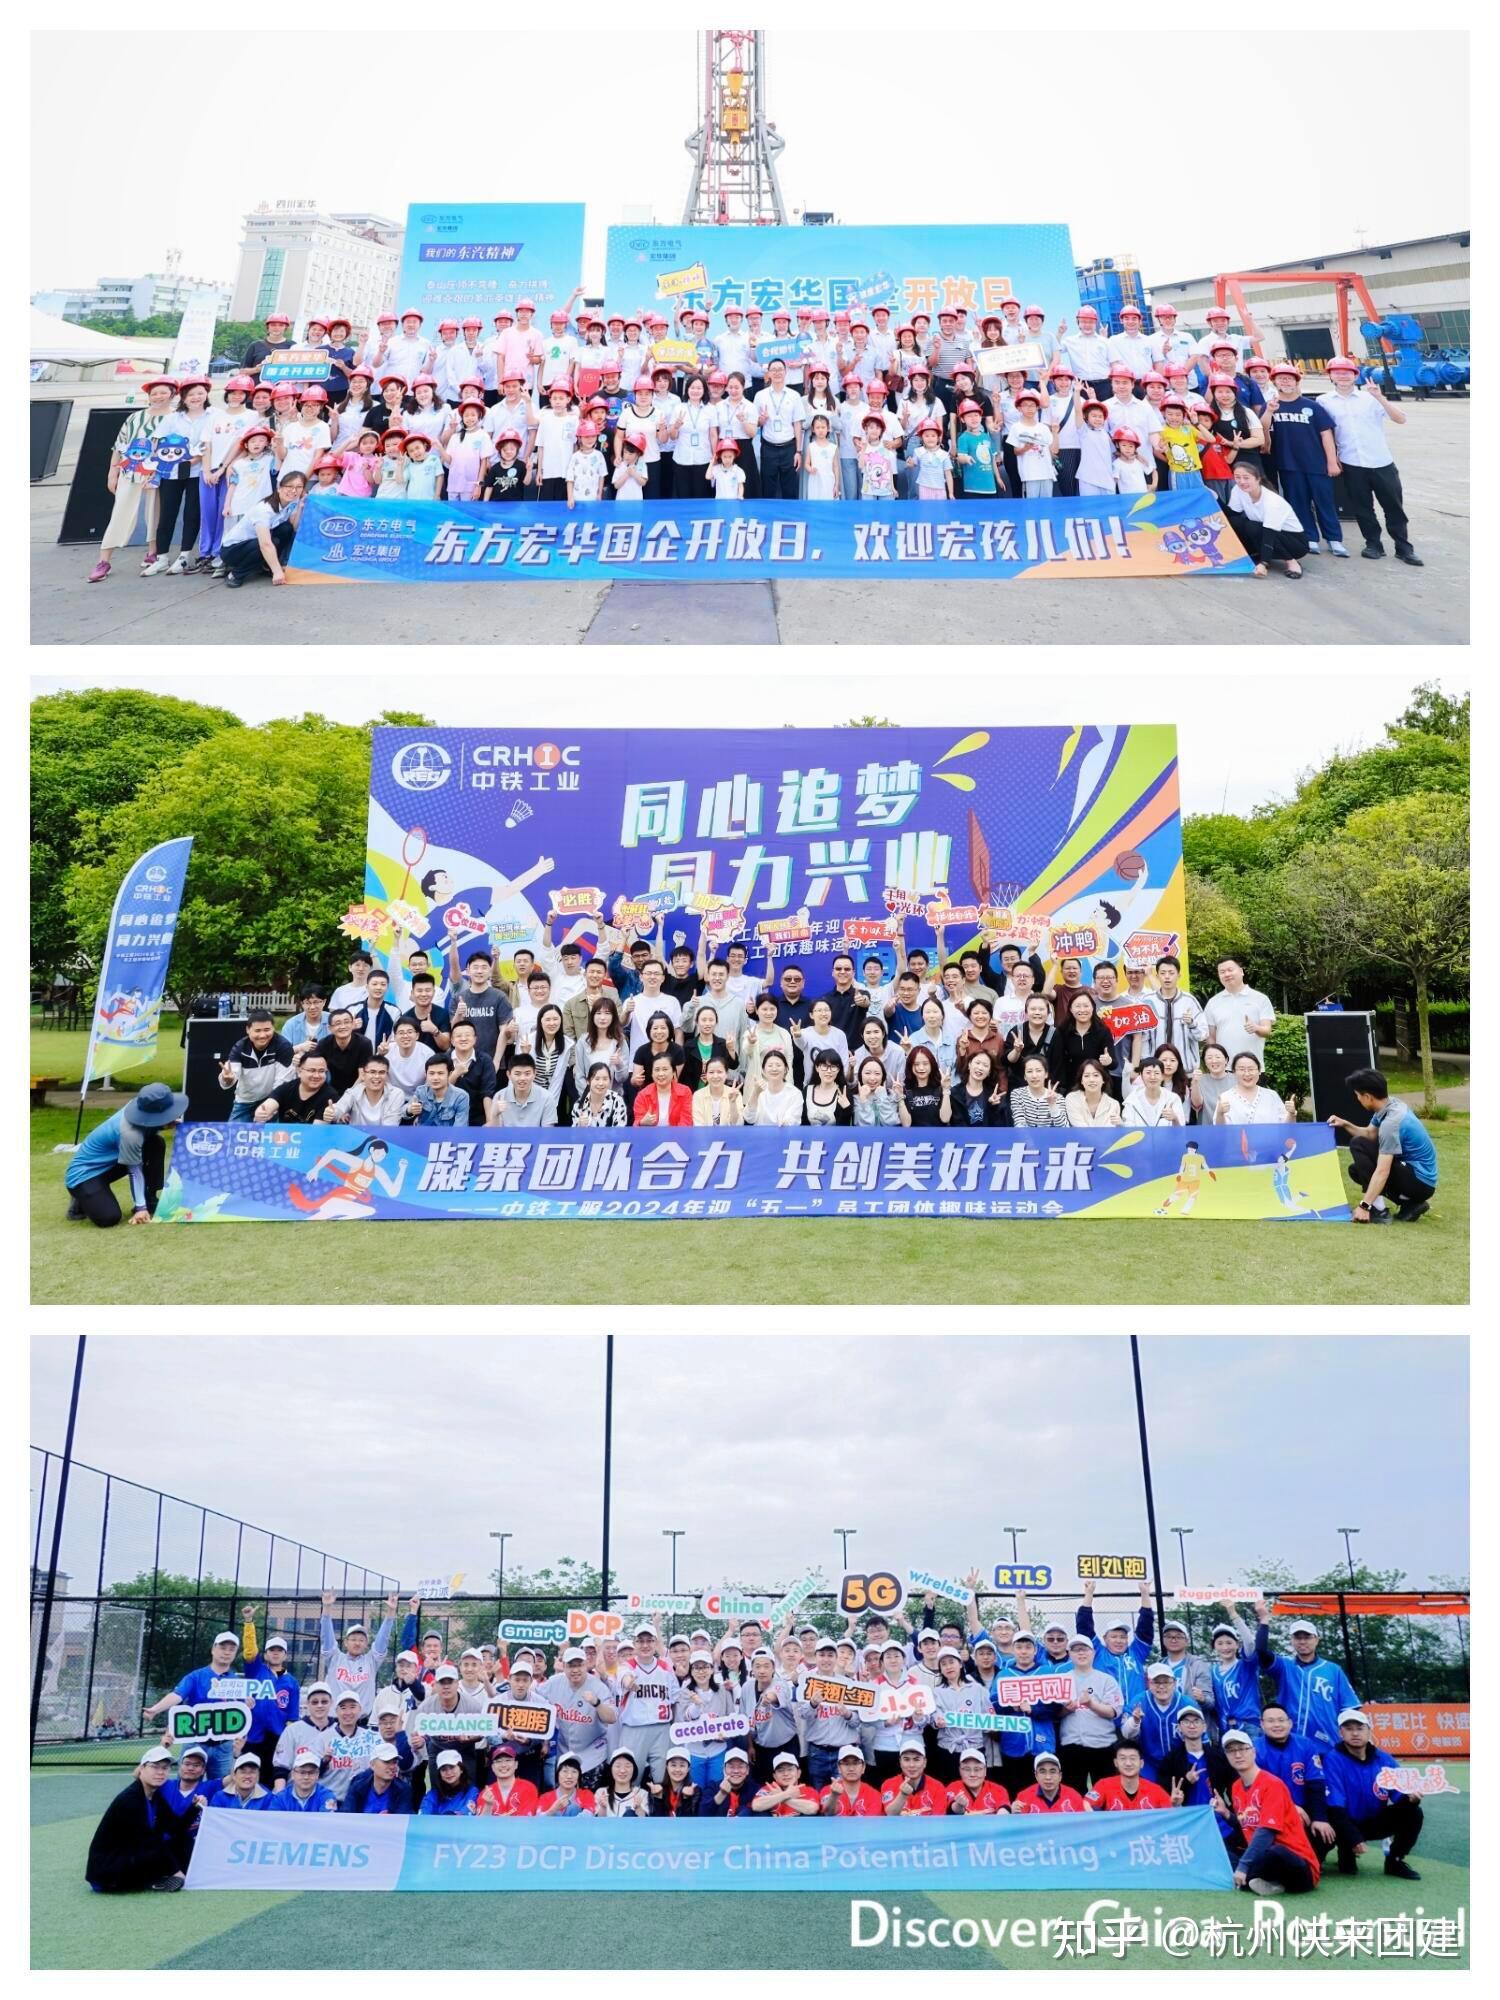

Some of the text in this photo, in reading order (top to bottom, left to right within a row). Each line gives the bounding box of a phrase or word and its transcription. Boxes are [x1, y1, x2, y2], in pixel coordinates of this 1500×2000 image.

[425, 246, 515, 260] 我们的东汽精神
[361, 518, 417, 532] 东方电气
[351, 544, 401, 557] 宏华集团
[472, 744, 581, 768] CRHIC
[471, 771, 581, 791] 中铁工业
[620, 760, 923, 848] 同心追梦
[562, 892, 593, 907] 必胜
[1054, 930, 1096, 953] 冲鸭
[1112, 1011, 1151, 1029] 加油
[236, 1129, 302, 1145] CRHIC
[234, 1145, 300, 1159] 中铁工业
[416, 1140, 1097, 1193] 凝聚团队合力 共创美好未来
[998, 1567, 1049, 1587] RTLS
[1078, 1554, 1147, 1580] 到处跑
[843, 1575, 902, 1612] 5G
[909, 1569, 970, 1602] wireless
[1178, 1587, 1259, 1602] RuggedCom
[630, 1593, 691, 1612] Discover
[706, 1594, 765, 1615] China
[503, 1612, 623, 1643] smart DCP
[246, 1680, 275, 1699] PA
[1312, 1676, 1334, 1702] KC
[554, 1702, 594, 1724] Phillies
[657, 1703, 671, 1720] 21
[944, 1711, 1031, 1732] SIEMENS
[175, 1709, 246, 1737] RFID
[419, 1717, 494, 1732] SCALANCE
[674, 1717, 746, 1739] accelerate
[226, 1839, 371, 1869] SIEMENS
[433, 1842, 507, 1869] FY23
[517, 1844, 577, 1869] DCP
[586, 1842, 716, 1870] Discover
[725, 1842, 810, 1870] China
[821, 1842, 960, 1869] Potential
[970, 1841, 1100, 1874] Meeting
[1128, 1832, 1193, 1867] 成都
